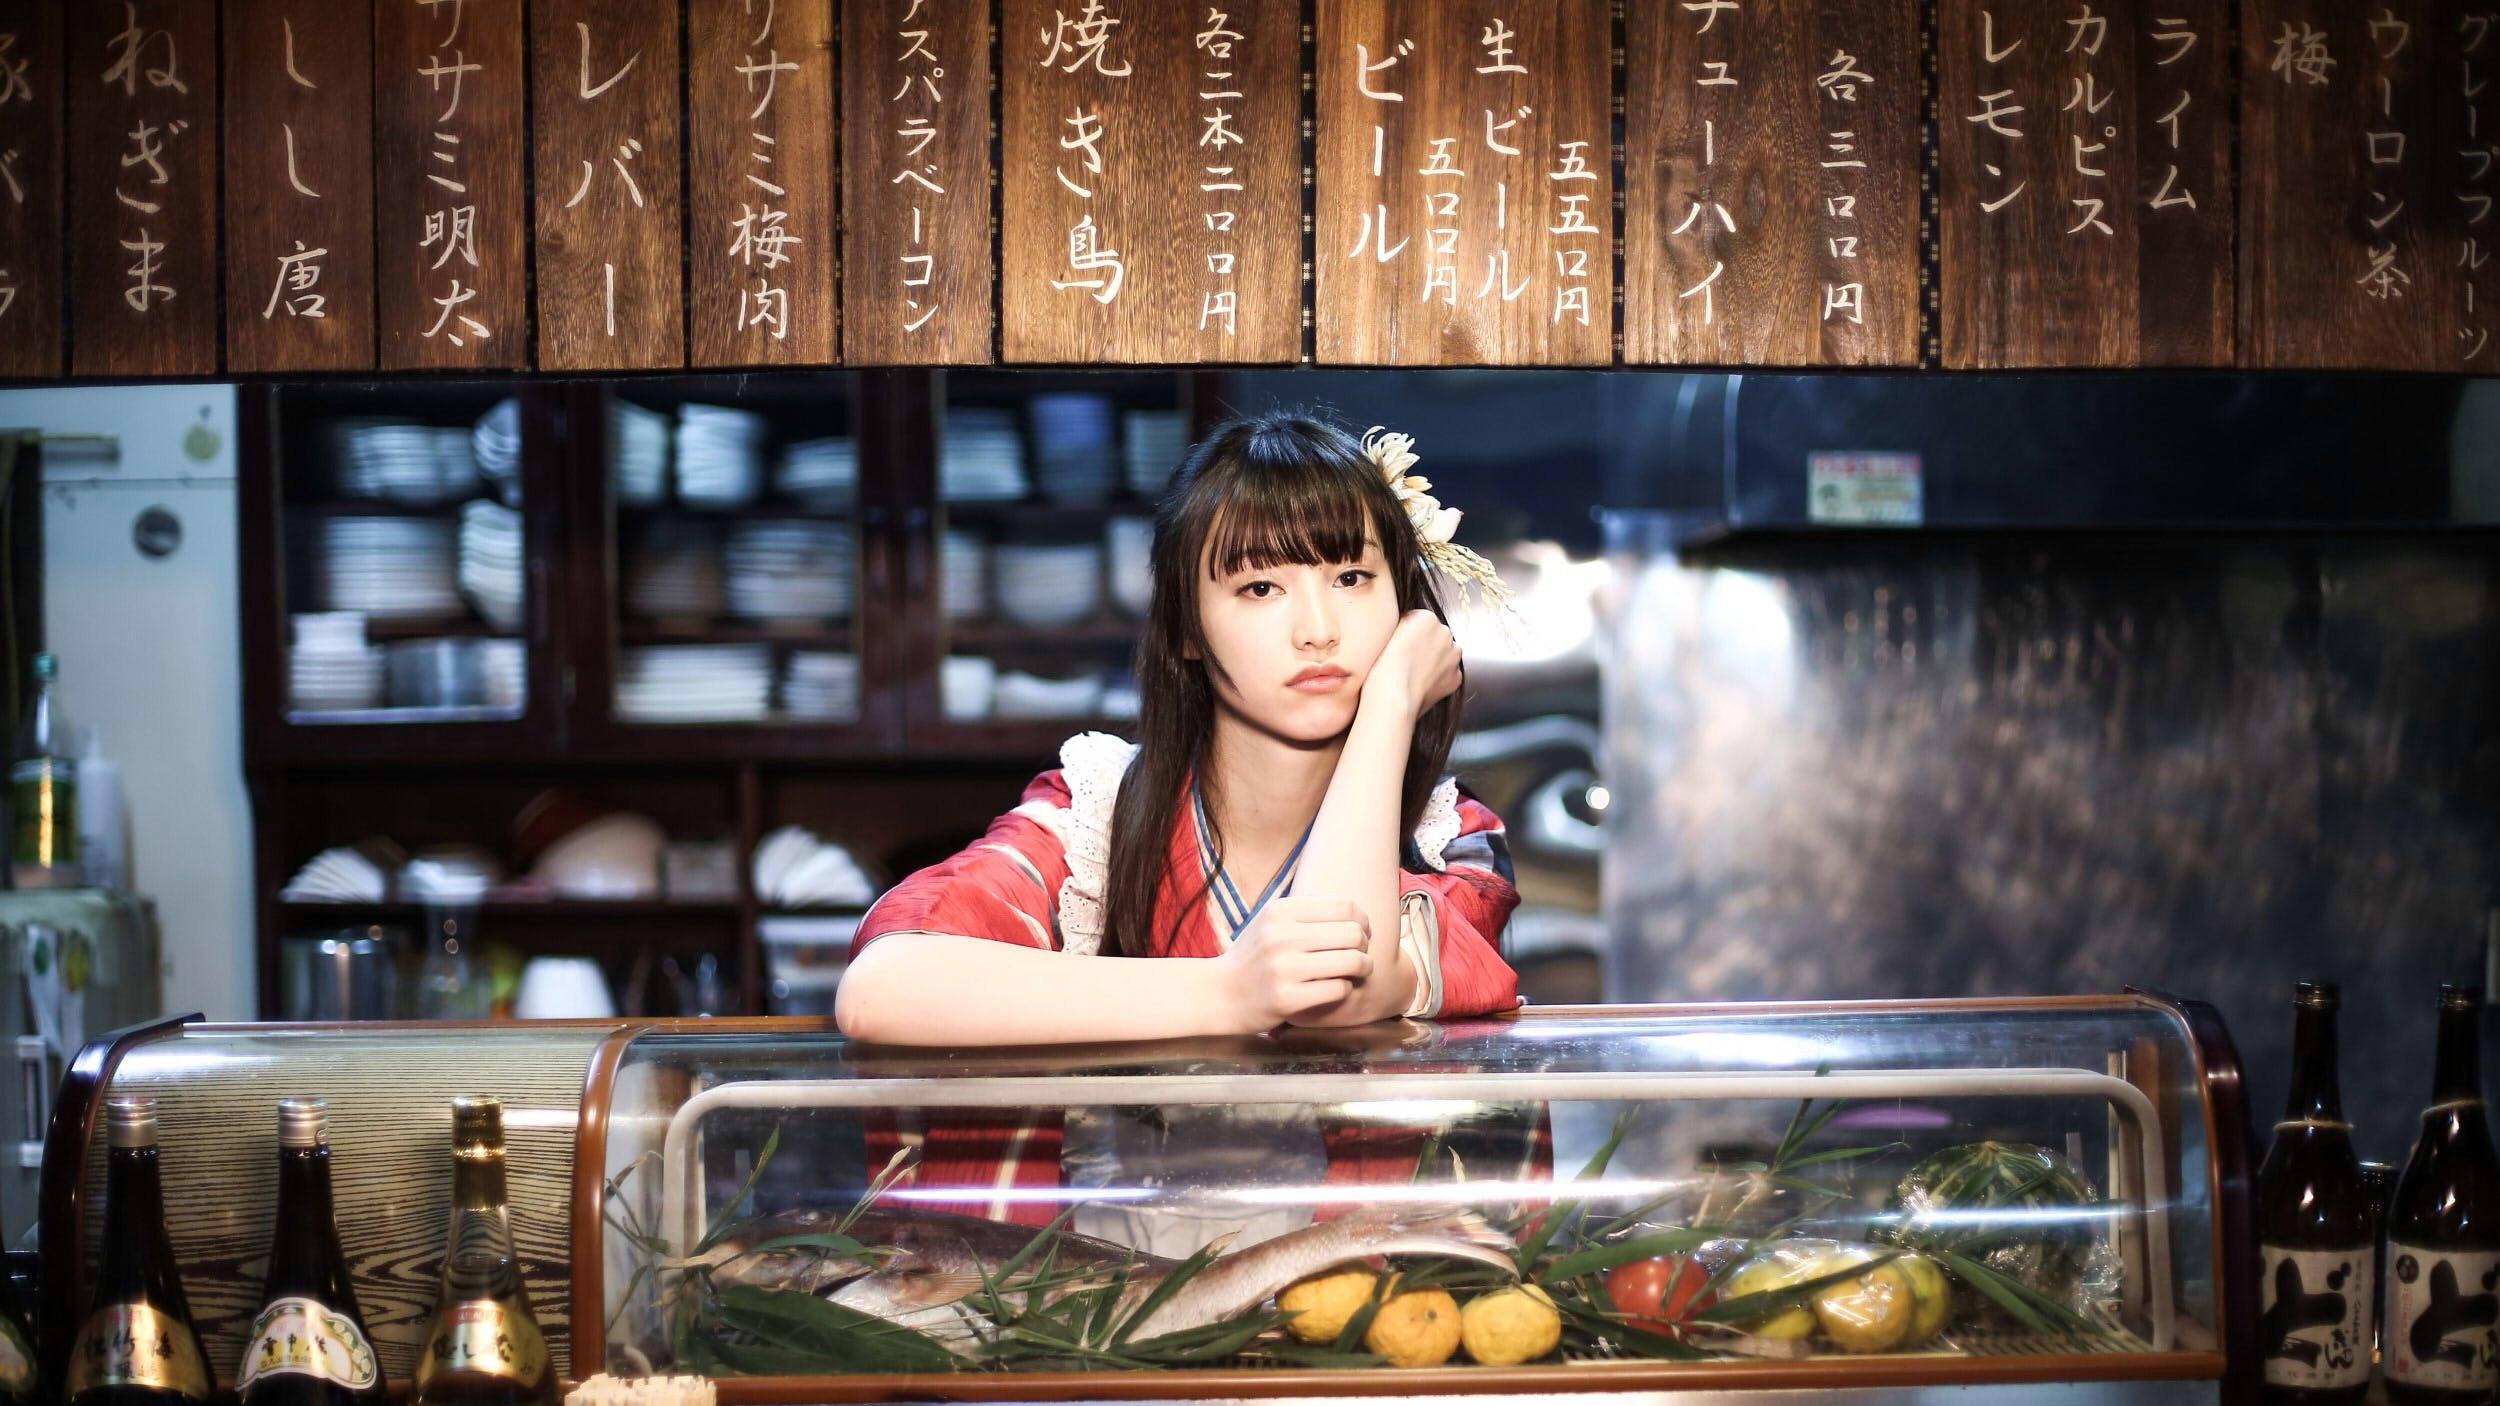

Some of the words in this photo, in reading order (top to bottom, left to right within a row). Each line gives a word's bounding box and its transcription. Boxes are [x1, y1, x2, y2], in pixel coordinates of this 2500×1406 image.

[102, 17, 189, 312] ねぎま
[262, 17, 328, 319] しし唐
[565, 21, 643, 337] レバー
[1039, 0, 1132, 304] 焼き鳥
[1349, 40, 1415, 264] ビール
[1476, 18, 1532, 300] 生ビール
[1672, 0, 1740, 325] チューハイ
[1967, 11, 2026, 212] レモン
[2062, 5, 2117, 235] カルピス
[2149, 17, 2198, 210] ライム
[2271, 22, 2337, 85] 梅
[2356, 8, 2411, 300] ウーロン茶
[2456, 13, 2500, 361] グレープフルーツ
